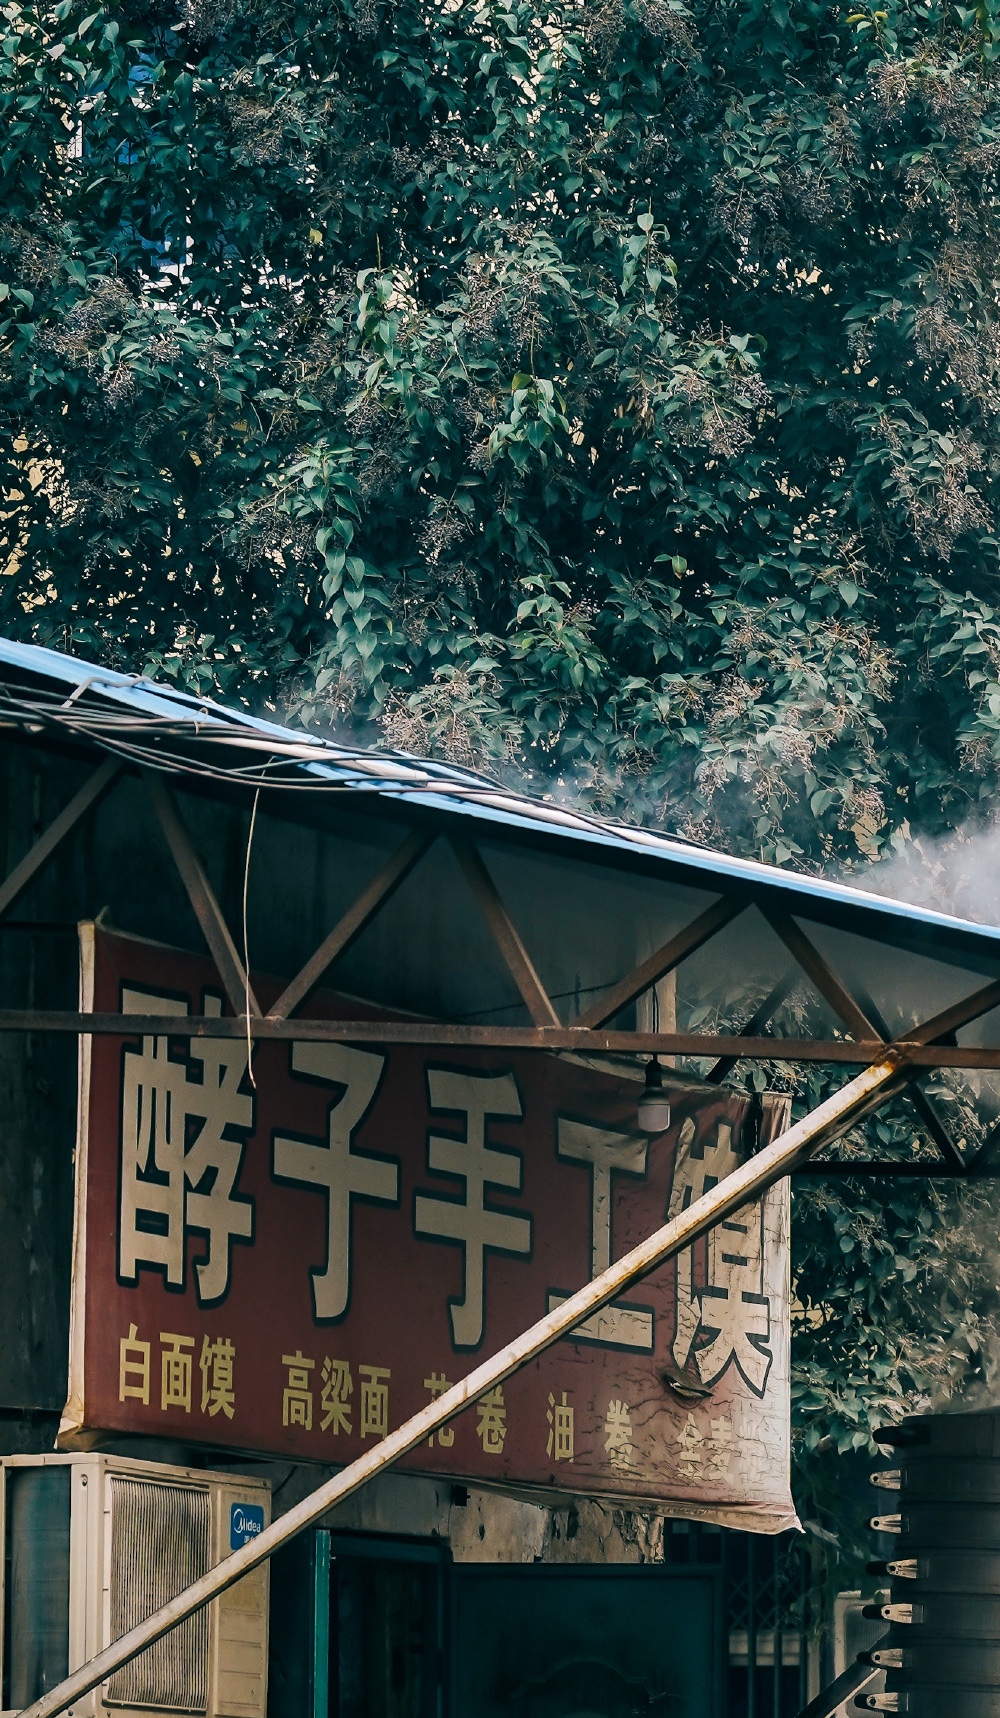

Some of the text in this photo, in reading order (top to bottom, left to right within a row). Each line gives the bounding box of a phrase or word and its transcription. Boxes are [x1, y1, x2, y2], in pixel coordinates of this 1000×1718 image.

[118, 984, 773, 1396] 酵子手工馍
[118, 1322, 236, 1420] 白面馍
[280, 1350, 392, 1440] 高梁面
[233, 1508, 261, 1534] Midea
